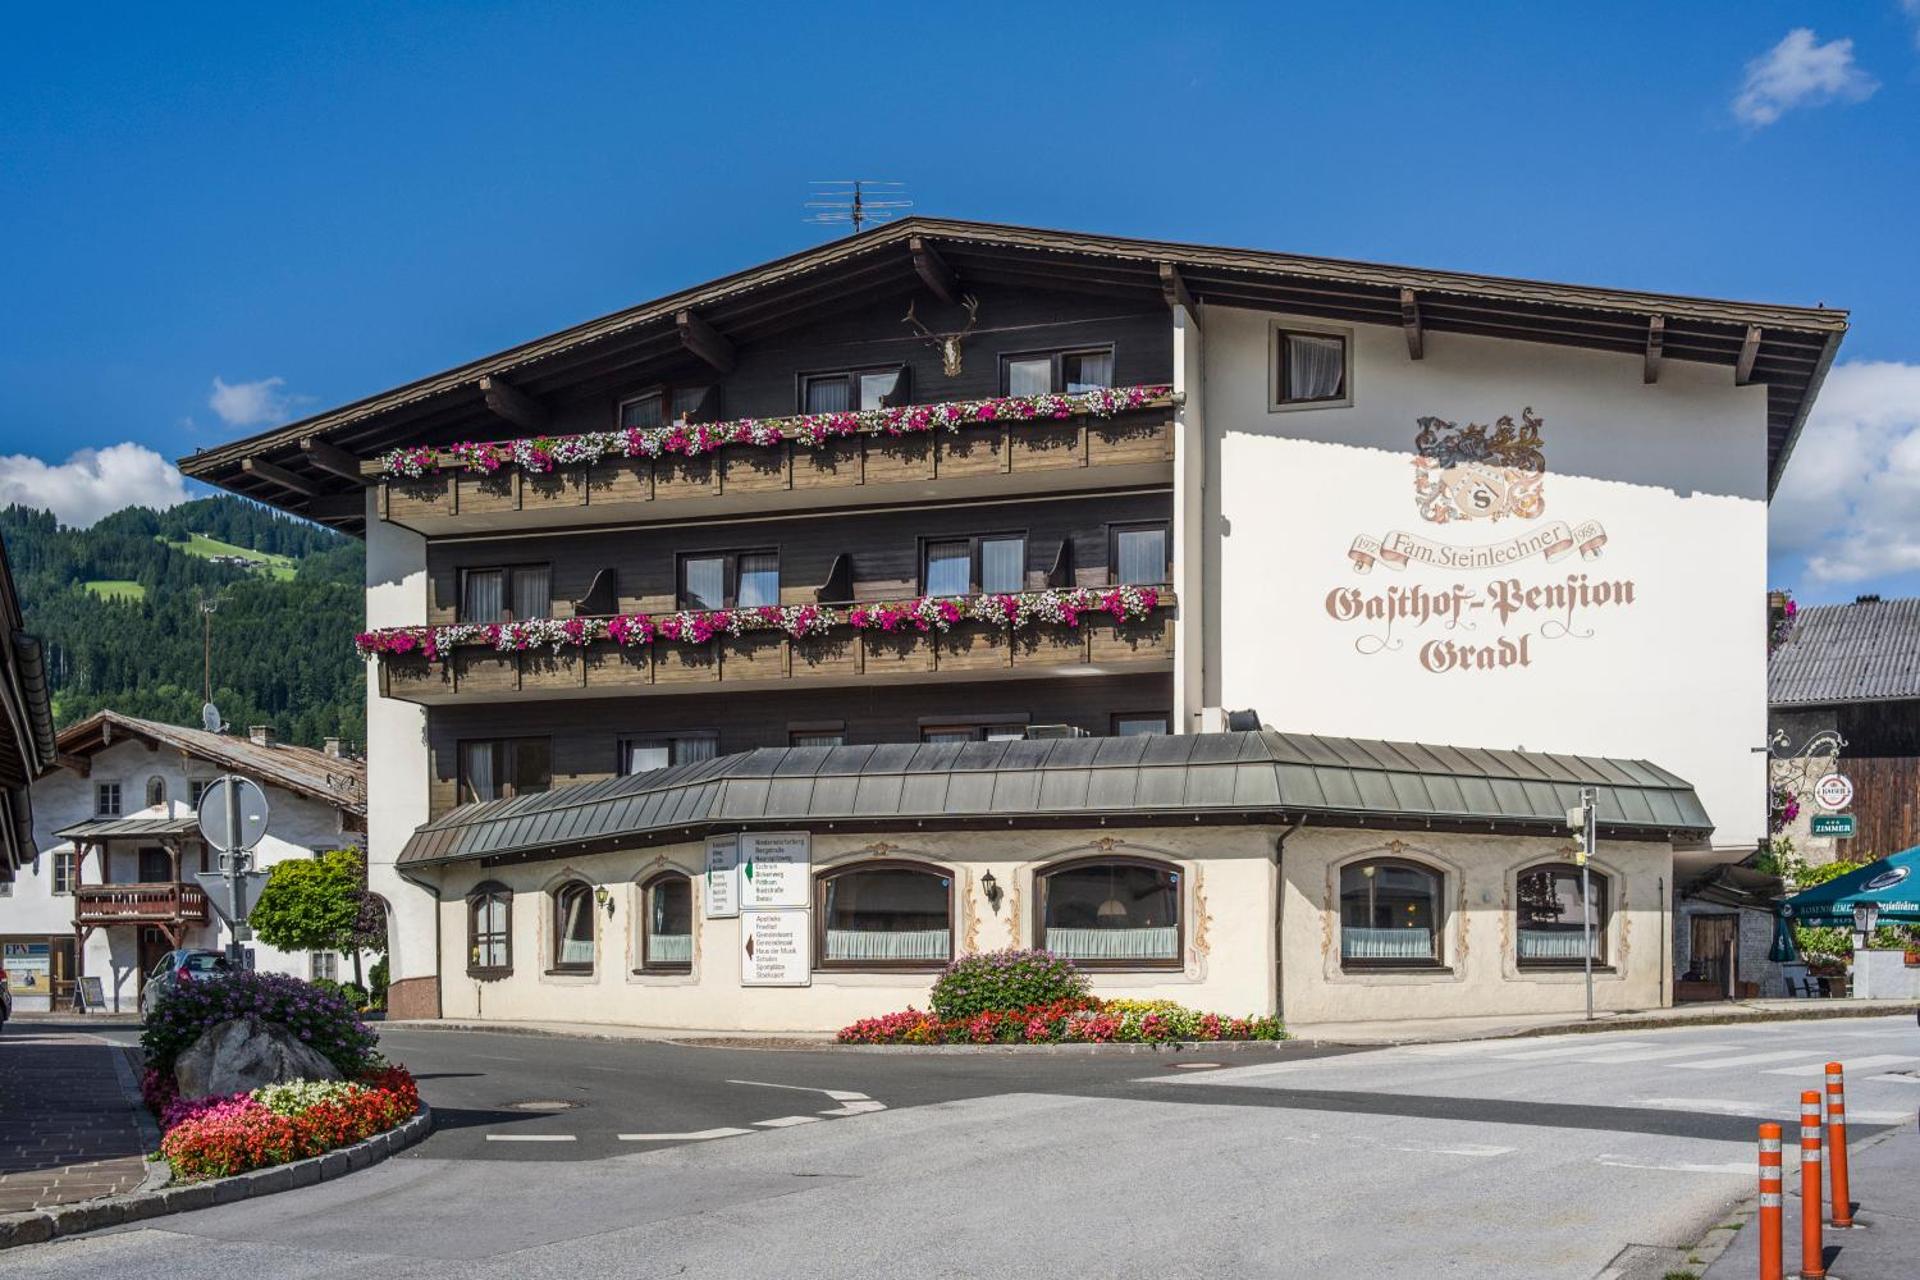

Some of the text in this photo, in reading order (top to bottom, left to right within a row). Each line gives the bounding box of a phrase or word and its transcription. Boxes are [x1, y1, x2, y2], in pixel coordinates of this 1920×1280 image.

[1473, 489, 1491, 509] S
[1393, 526, 1560, 568] Fam. Steinlechner
[1419, 633, 1532, 674] Gradl
[1815, 824, 1851, 833] ZIMMER
